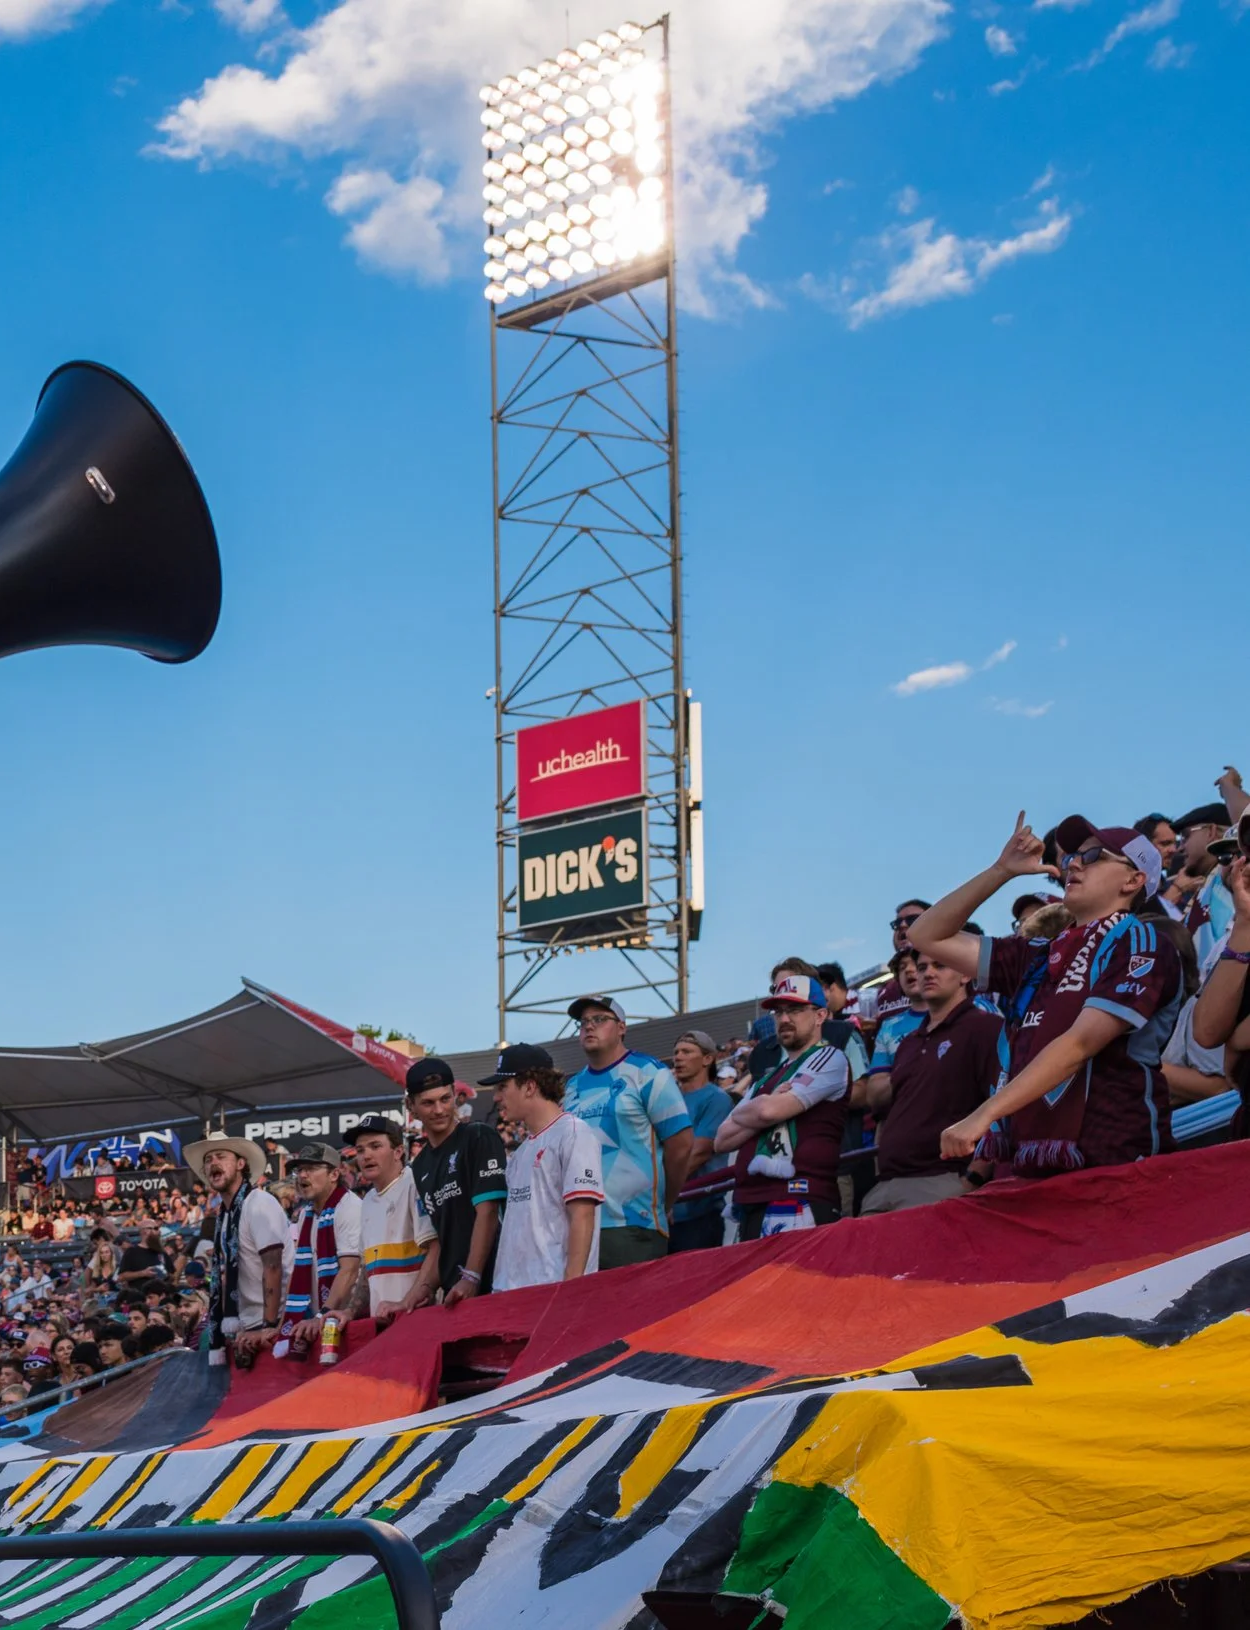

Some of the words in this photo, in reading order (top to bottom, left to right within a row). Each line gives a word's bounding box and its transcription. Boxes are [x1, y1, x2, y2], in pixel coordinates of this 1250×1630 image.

[538, 738, 622, 778] uchealth
[523, 836, 638, 902] DICK'S
[245, 1116, 330, 1140] PEPSI
[119, 1178, 168, 1192] TOYOTA
